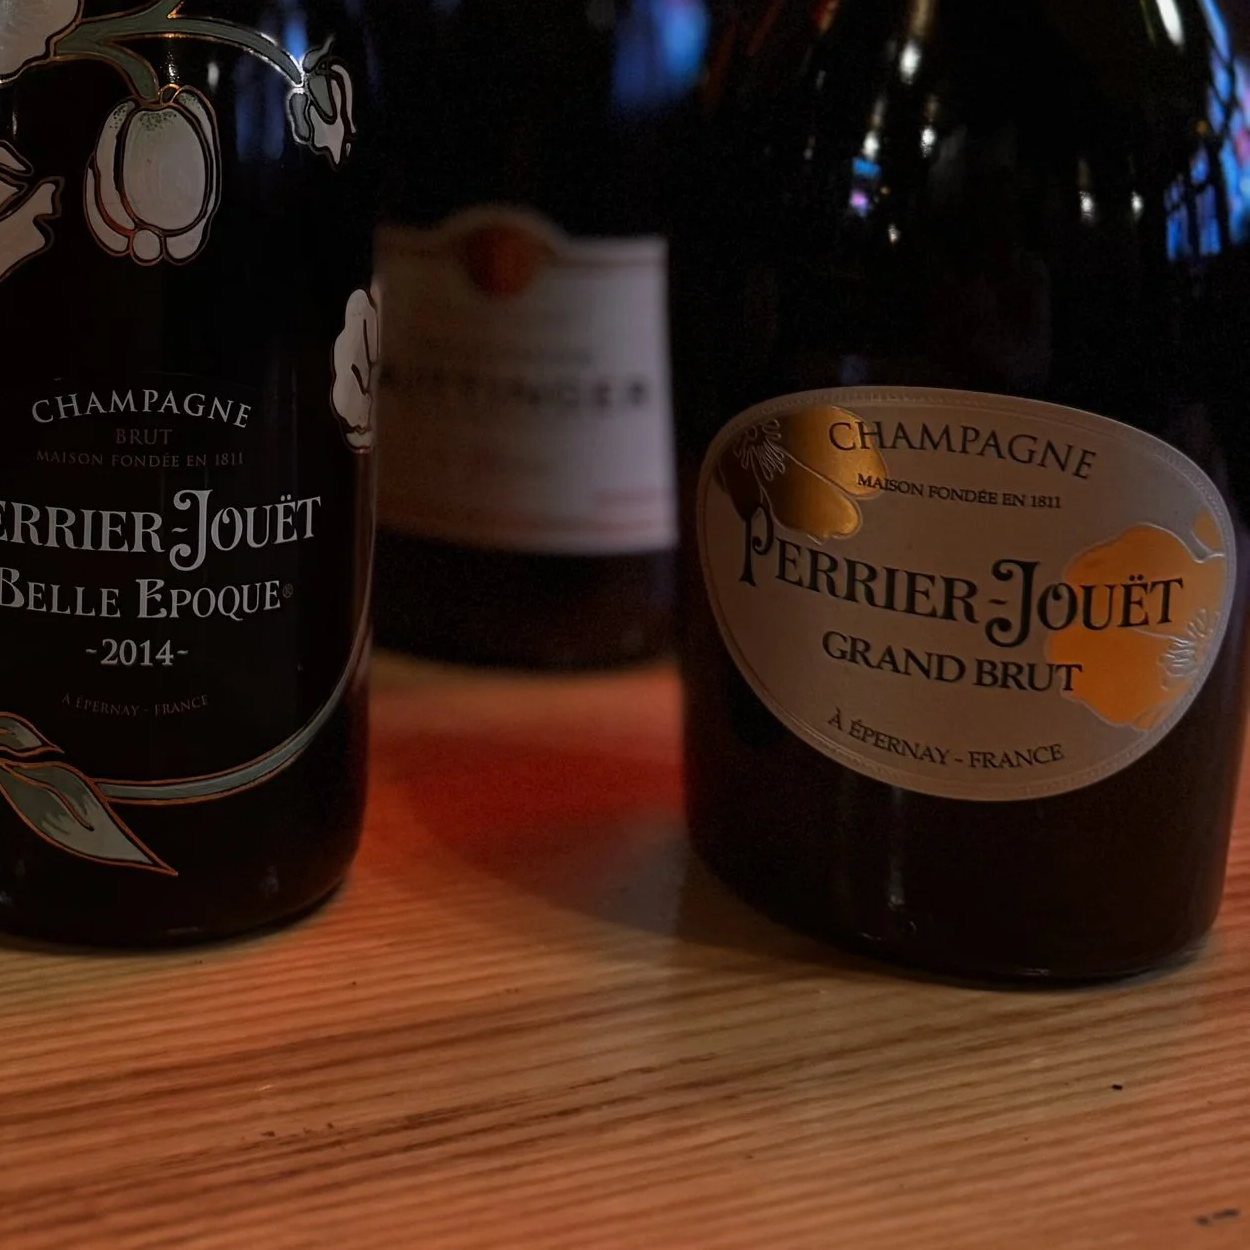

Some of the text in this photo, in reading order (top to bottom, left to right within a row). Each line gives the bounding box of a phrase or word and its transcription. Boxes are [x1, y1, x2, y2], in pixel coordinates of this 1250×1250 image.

[30, 388, 252, 430] CHAMPAGNE
[114, 428, 174, 446] BRUT
[828, 420, 1097, 480] CHAMPAGNE
[35, 450, 245, 469] MAISON FONDÉE EN 1811
[856, 473, 1062, 510] MAISON FONDÉE EN 1811
[738, 504, 1184, 648] PERRIER-JOUËT
[822, 630, 1083, 692] GRAND BRUT
[75, 693, 140, 717] ÉPERNAY
[154, 694, 209, 717] FRANCE
[827, 707, 844, 733] À
[848, 717, 952, 768] ÉPERNAY
[968, 742, 1066, 770] FRANCE
